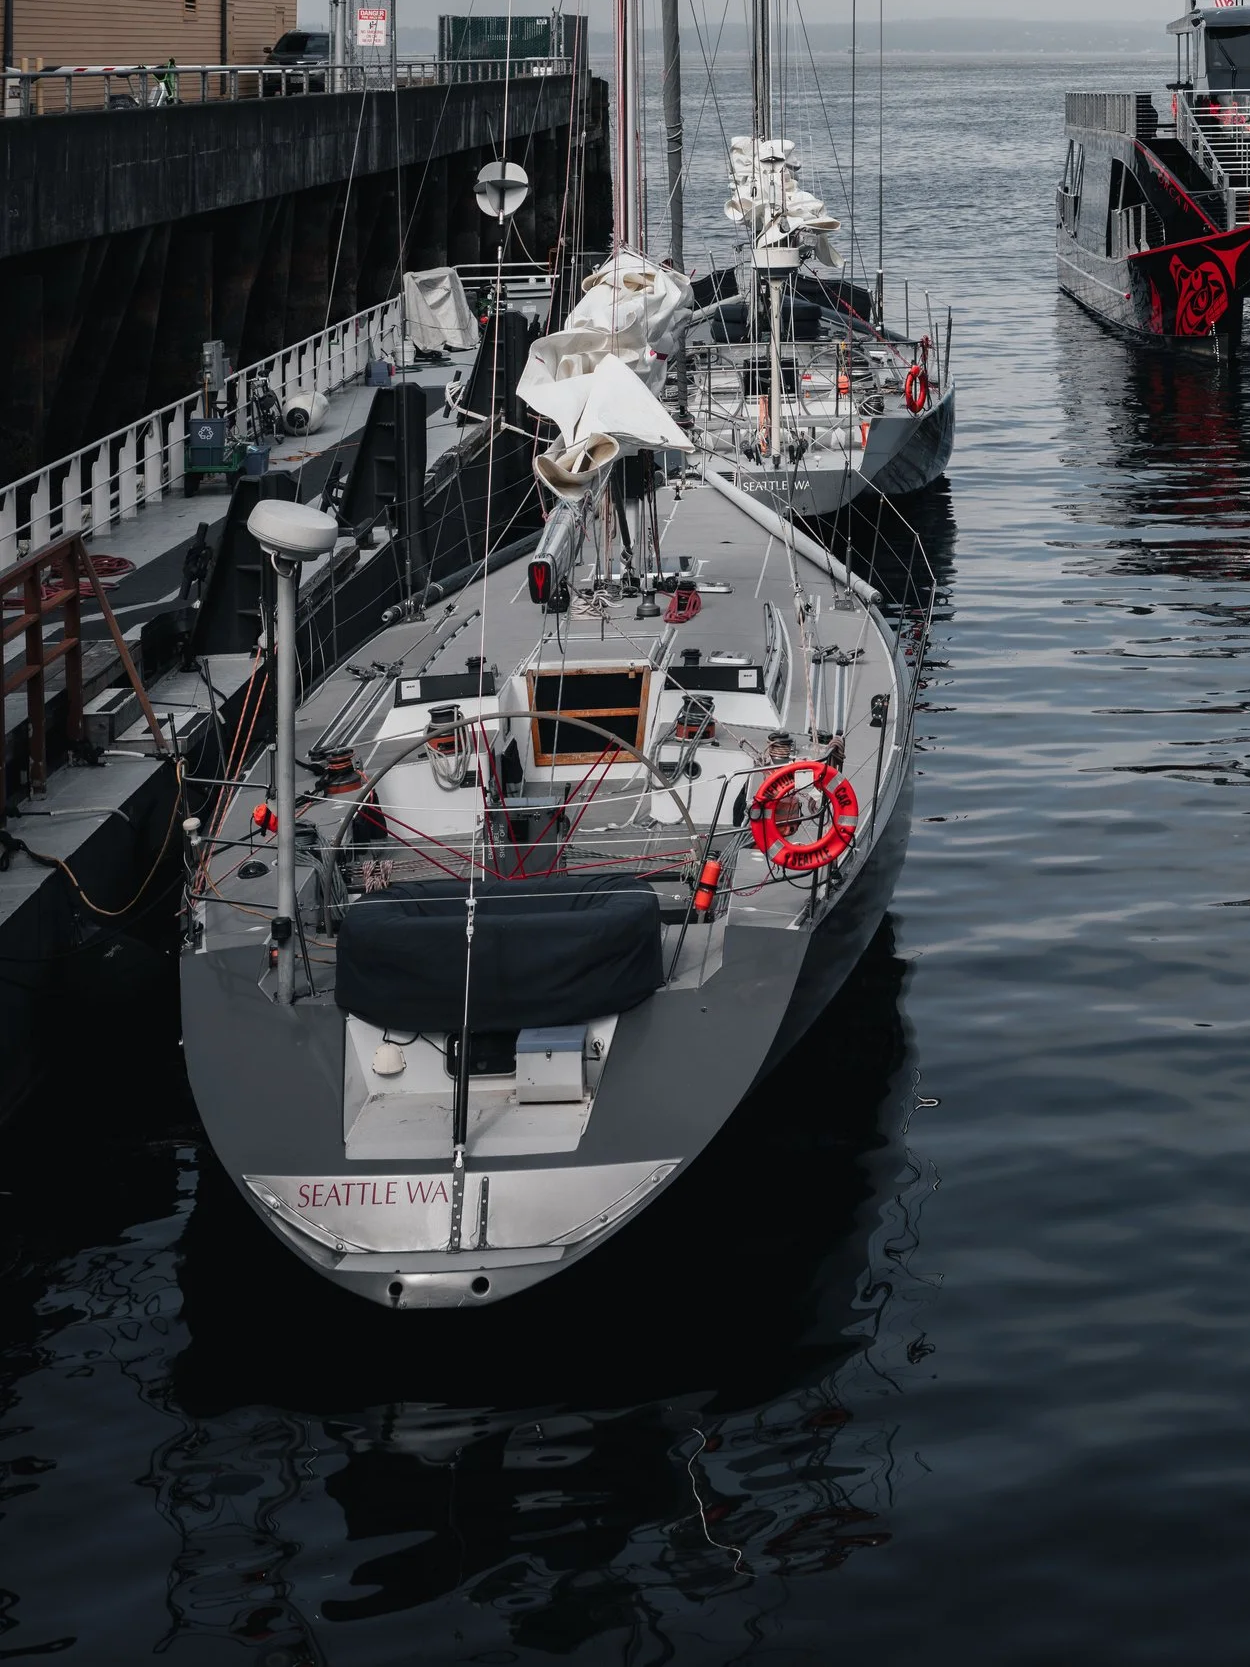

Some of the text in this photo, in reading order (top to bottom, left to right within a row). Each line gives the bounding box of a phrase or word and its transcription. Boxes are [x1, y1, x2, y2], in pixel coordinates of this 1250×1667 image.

[743, 480, 813, 492] SEATTLE WA
[834, 786, 852, 809] CAR
[791, 846, 833, 867] SEATTLE
[297, 1180, 449, 1208] SEATTLE WA
